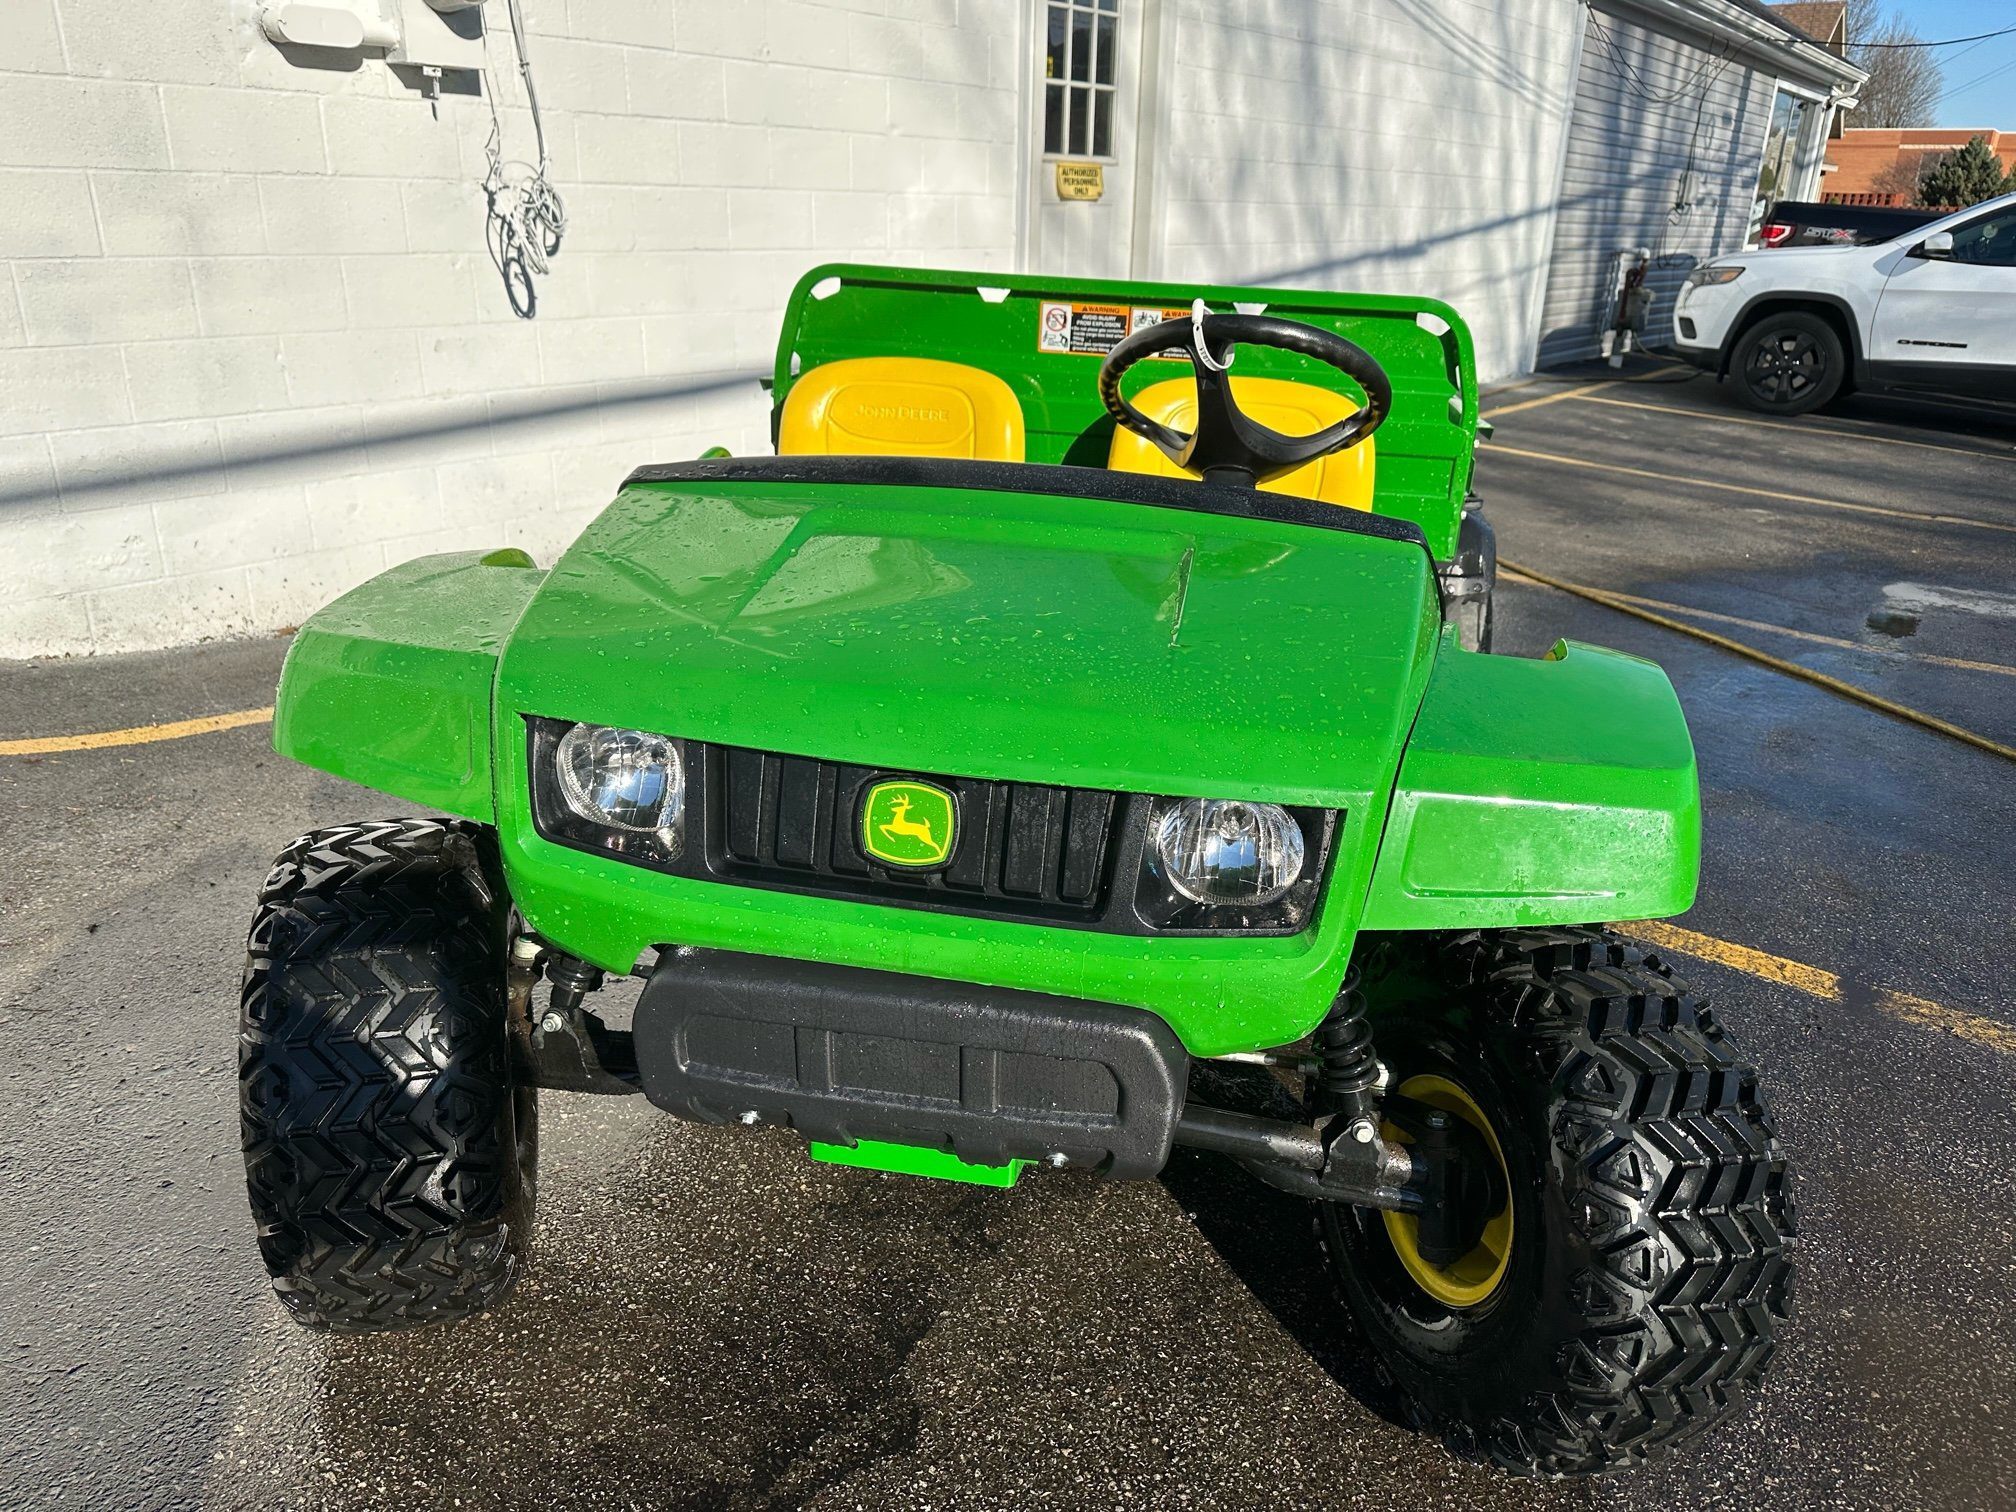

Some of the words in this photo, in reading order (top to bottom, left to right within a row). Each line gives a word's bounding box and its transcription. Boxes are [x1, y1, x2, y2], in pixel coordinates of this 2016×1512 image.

[1073, 187, 1089, 195] ONLY
[1088, 306, 1120, 314] WARNING
[855, 404, 896, 418] JOHN
[898, 405, 950, 421] DEERE
